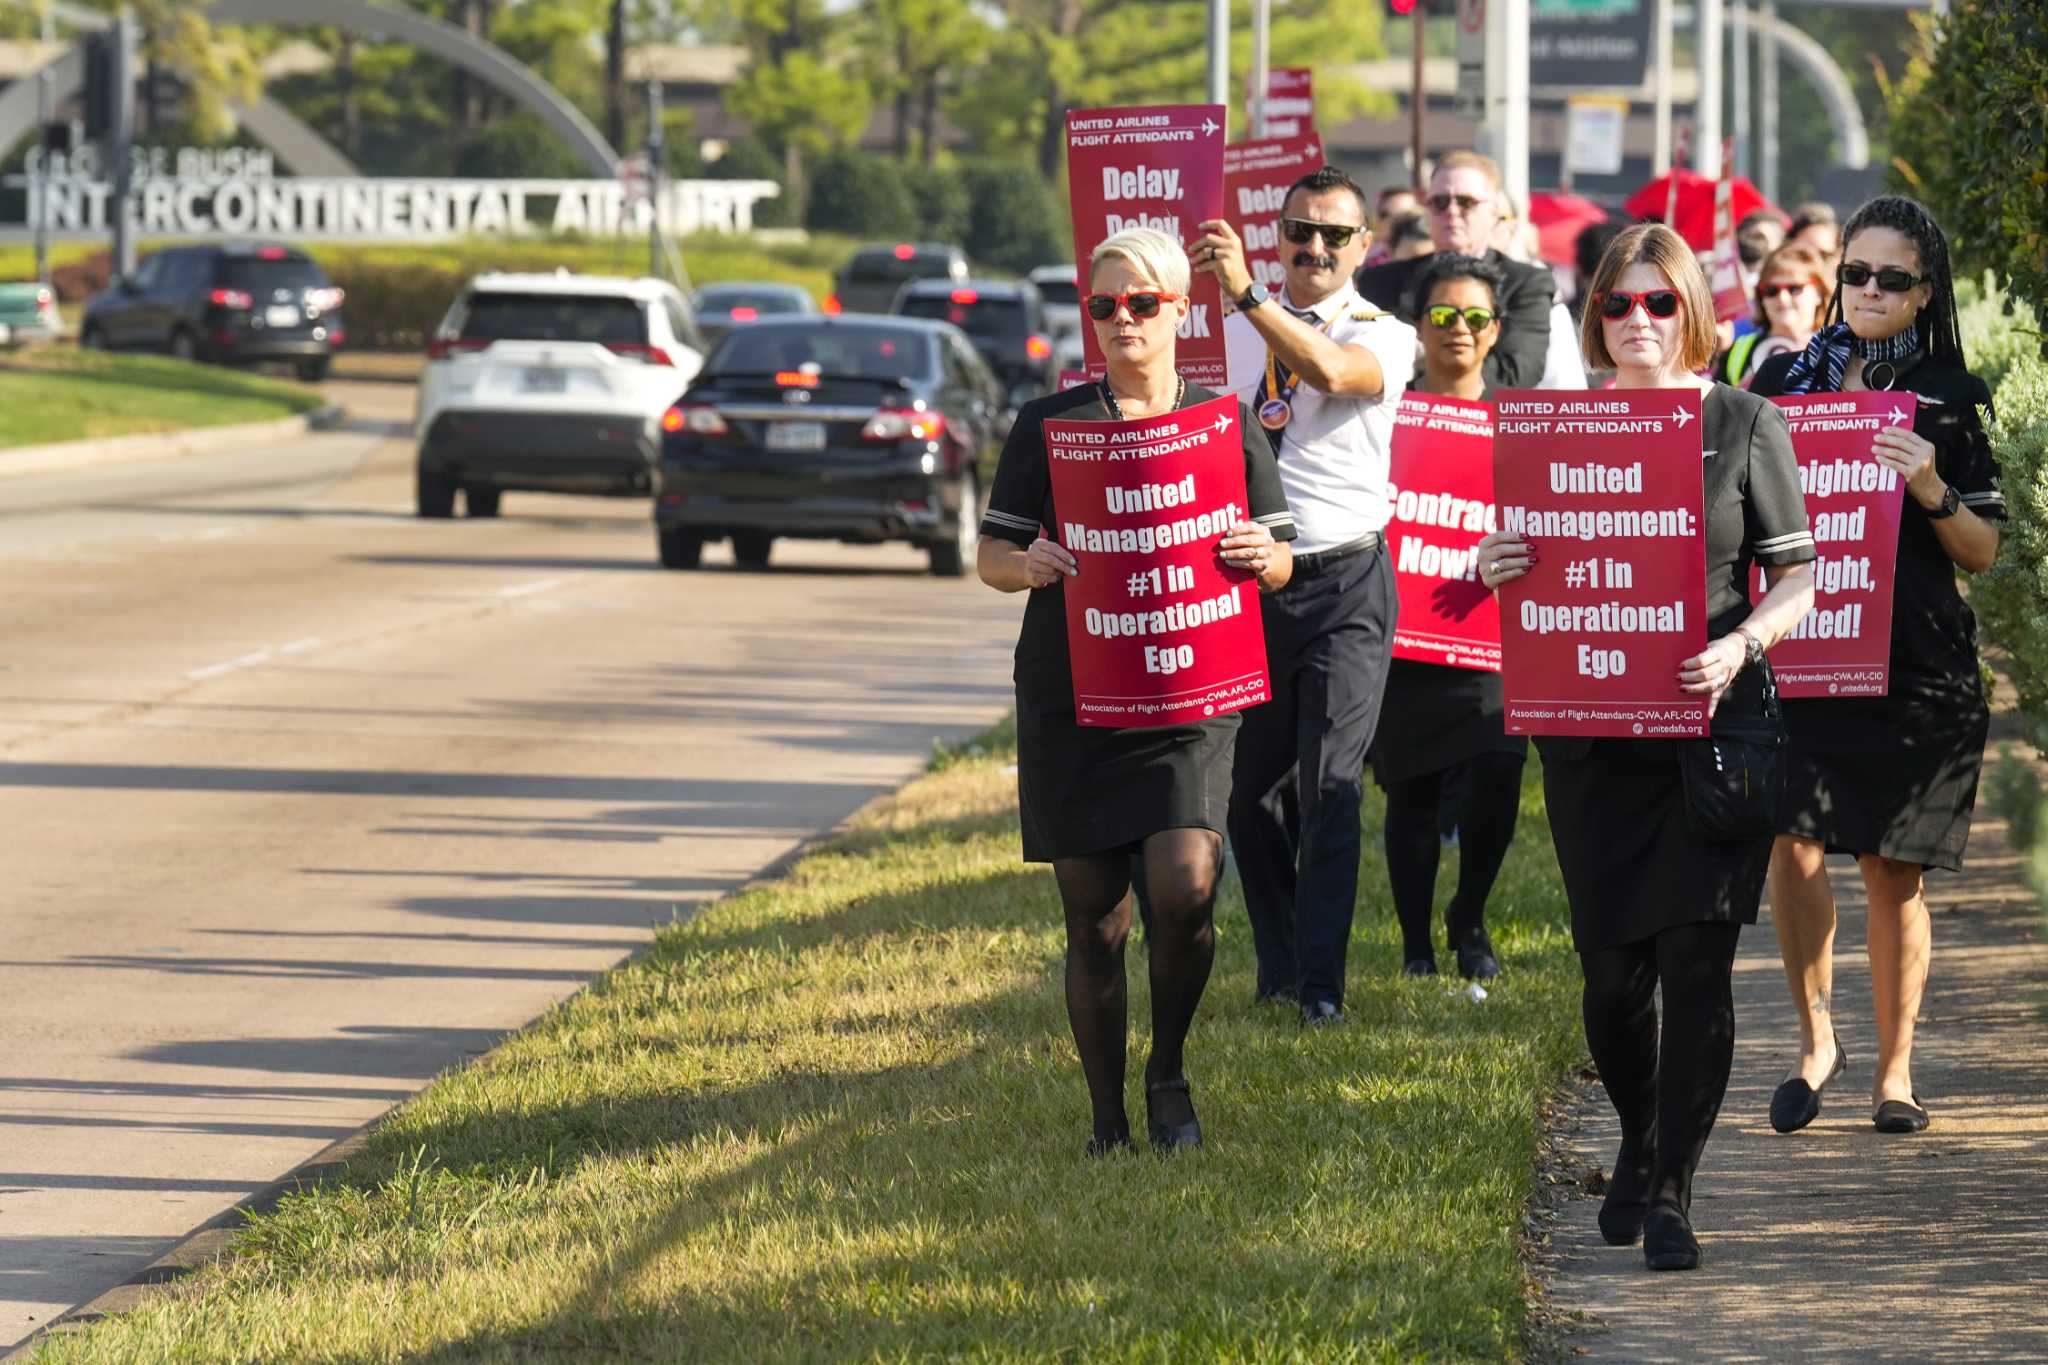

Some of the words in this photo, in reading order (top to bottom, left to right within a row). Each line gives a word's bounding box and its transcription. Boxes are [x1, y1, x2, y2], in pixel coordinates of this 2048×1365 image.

[1071, 119, 1112, 130] UNITED
[1115, 116, 1170, 127] AIRLINES
[1071, 134, 1110, 146] FLIGHT
[1113, 131, 1194, 144] ATTENDANTS
[25, 145, 167, 177] GEOGE
[176, 146, 274, 178] BUSH
[1102, 165, 1184, 200] Delay,
[1237, 184, 1290, 215] Dela
[1400, 400, 1430, 412] ITED
[1431, 404, 1489, 421] AIRLINES
[1499, 402, 1554, 414] UNITED
[1558, 402, 1630, 414] AIRLINES
[1783, 406, 1803, 417] TED
[1805, 402, 1857, 415] AIRLINES
[1051, 431, 1106, 444] UNITED
[1110, 423, 1180, 443] AIRLINES
[1426, 418, 1494, 437] ATTENDAN
[1499, 422, 1551, 433] FLIGHT
[1555, 421, 1663, 433] ATTENDANTS
[1801, 419, 1880, 432] ATTENDANTS
[1053, 448, 1104, 461] FLIGHT
[1108, 433, 1209, 461] ATTENDANTS
[1550, 462, 1642, 494] United
[1798, 458, 1897, 497] ighten
[1105, 474, 1196, 514] United
[1386, 482, 1497, 534] Contrac
[1064, 502, 1243, 553] Management:
[1503, 505, 1696, 541] Management:
[1814, 506, 1866, 542] and
[1398, 535, 1479, 581] Now!
[1565, 558, 1599, 588] #1
[1605, 558, 1633, 588] in
[1127, 568, 1163, 597] #1
[1166, 564, 1195, 593] in
[1810, 555, 1876, 594] ight,
[1085, 586, 1242, 639] Operational
[1520, 600, 1684, 634] Operational
[1782, 604, 1862, 640] ited!
[1144, 644, 1194, 675] Ego
[1577, 644, 1627, 679] Ego
[1080, 703, 1125, 713] Association
[1127, 703, 1136, 713] of
[1138, 703, 1160, 714] Flight
[1510, 709, 1556, 719] Association
[1557, 709, 1566, 719] of
[1567, 709, 1589, 721] Flight
[1648, 723, 1703, 735] unitedafa.org
